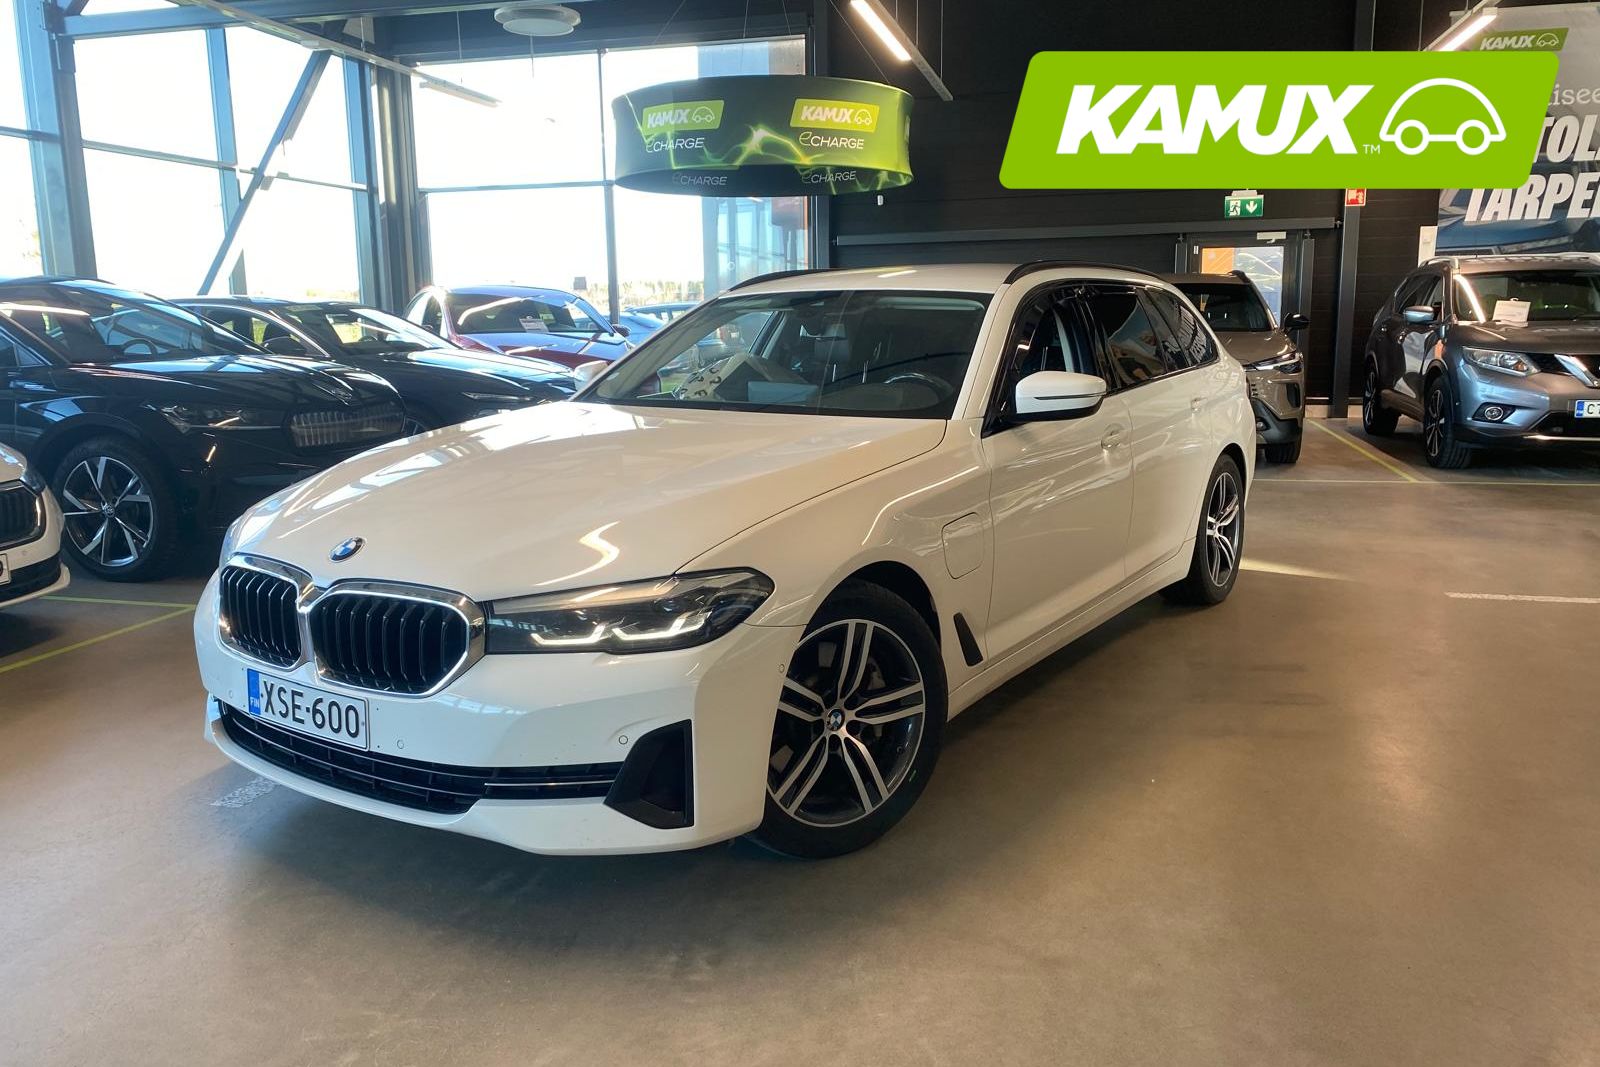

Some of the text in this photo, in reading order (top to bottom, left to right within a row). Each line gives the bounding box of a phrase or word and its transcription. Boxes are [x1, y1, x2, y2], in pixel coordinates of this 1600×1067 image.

[1480, 35, 1536, 50] KAMUX
[647, 108, 691, 129] KAMUX
[800, 105, 855, 124] KAMUX
[263, 680, 360, 739] XSE-600
